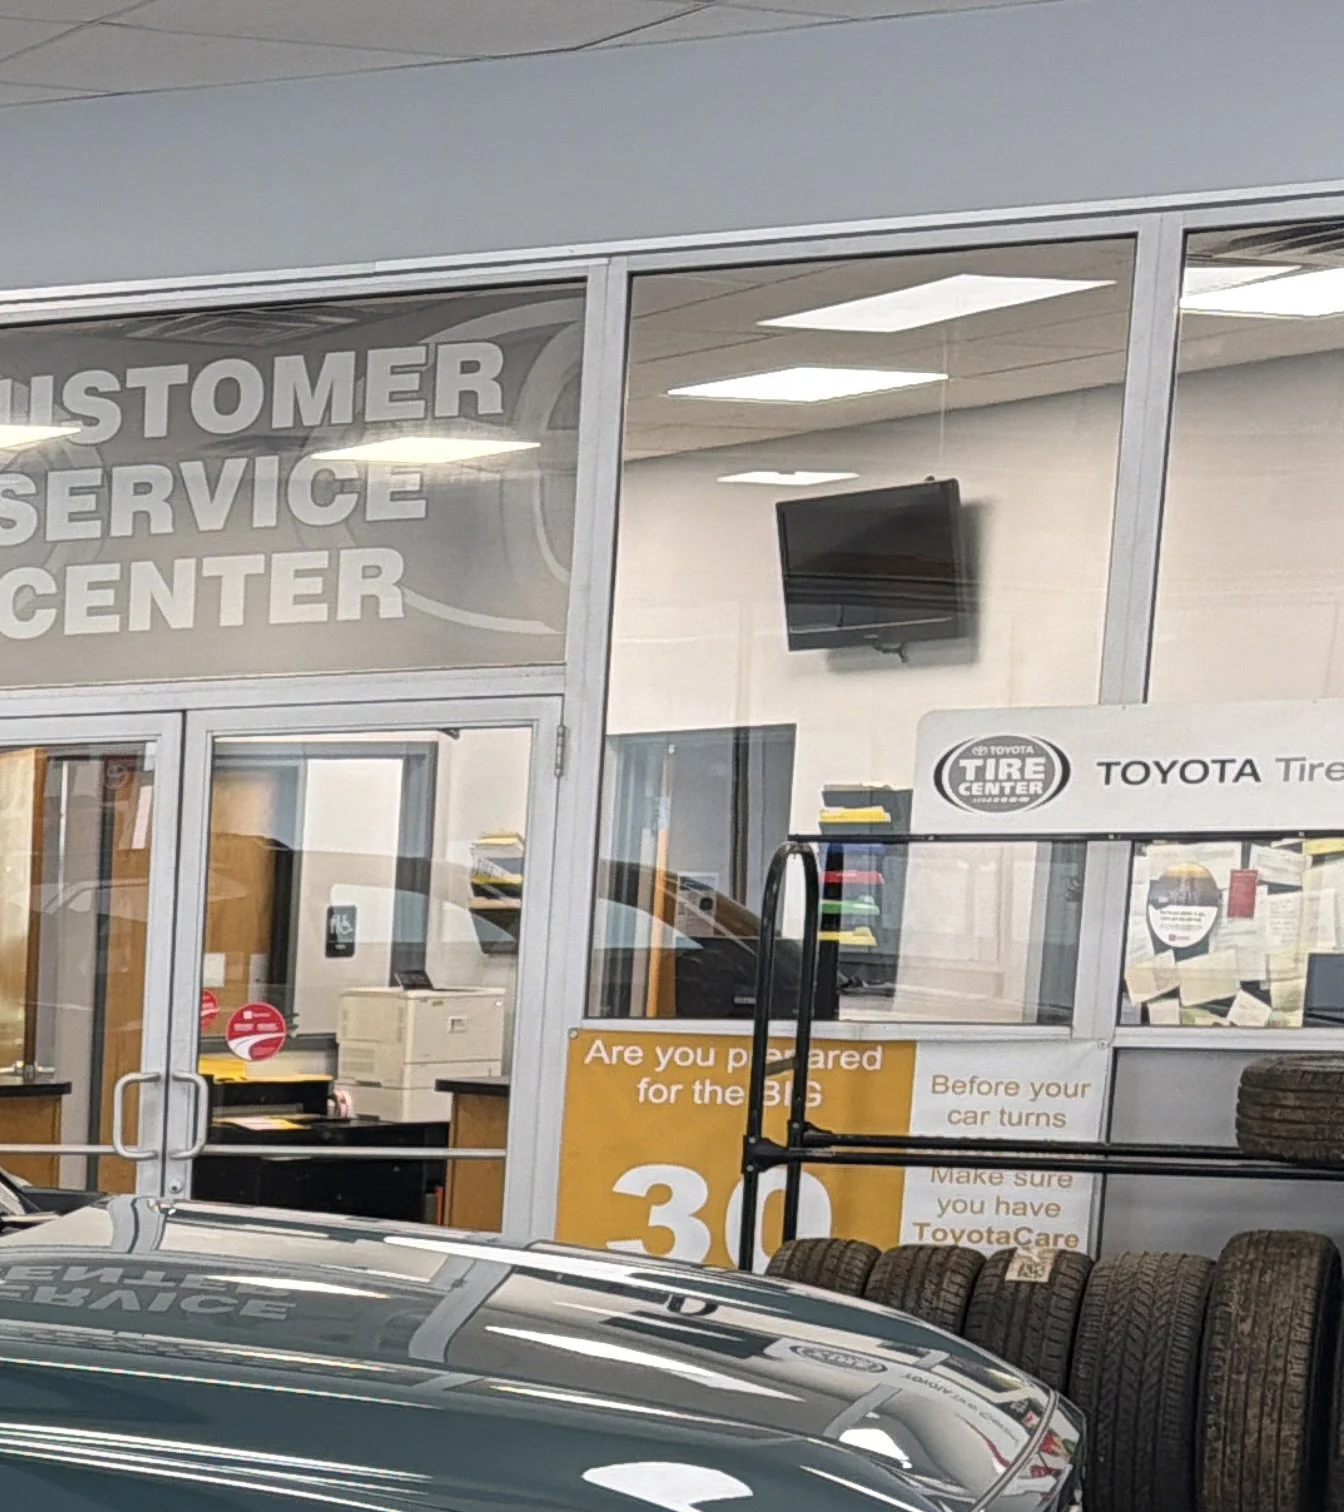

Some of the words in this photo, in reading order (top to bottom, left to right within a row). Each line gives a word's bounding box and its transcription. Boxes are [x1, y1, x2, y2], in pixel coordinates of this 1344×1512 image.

[990, 745, 1034, 755] TOYOTA
[959, 757, 1046, 781] TIRE
[1096, 758, 1262, 786] TOYOTA
[1275, 756, 1344, 783] Tire
[958, 781, 1044, 796] CENTER
[584, 1040, 643, 1066] Are
[655, 1046, 715, 1072] you
[727, 1045, 883, 1074] peared
[637, 1078, 683, 1104] for
[693, 1079, 745, 1106] the
[931, 1074, 1020, 1097] Before
[1029, 1080, 1091, 1102] your
[947, 1109, 990, 1126] car
[999, 1107, 1067, 1128] turns
[930, 1167, 1004, 1186] Make
[1013, 1171, 1073, 1189] sure
[936, 1197, 985, 1218] you
[995, 1195, 1061, 1218] have
[606, 1164, 832, 1278] 30
[913, 1222, 1080, 1248] ToyotaCare
